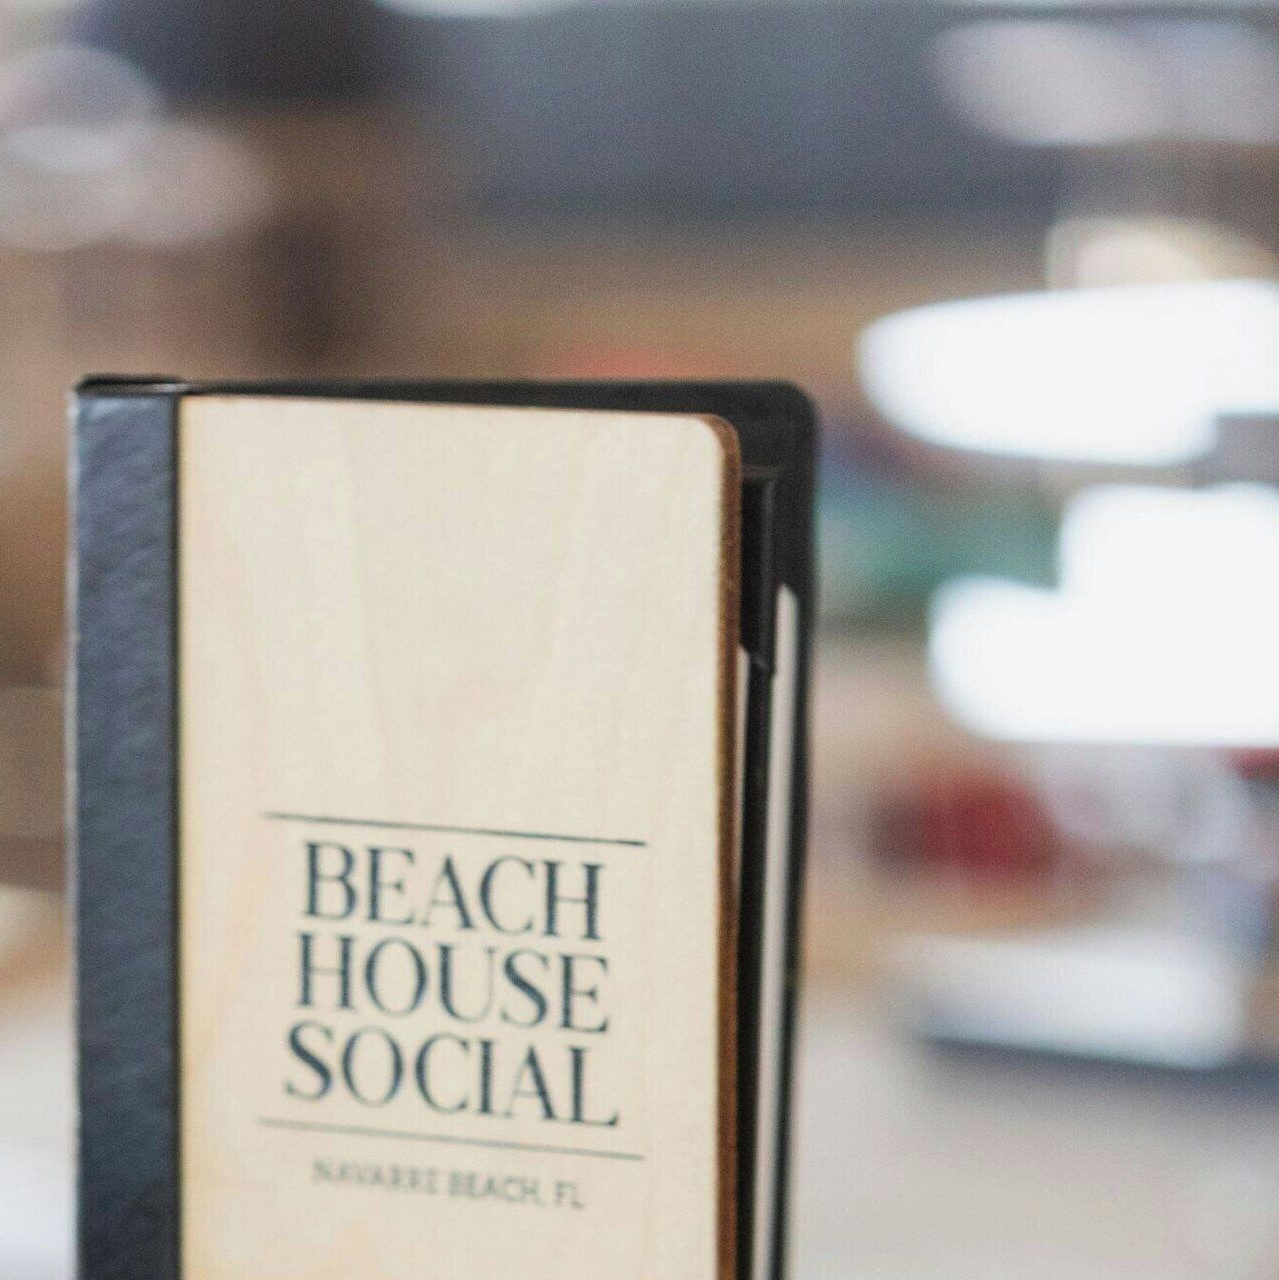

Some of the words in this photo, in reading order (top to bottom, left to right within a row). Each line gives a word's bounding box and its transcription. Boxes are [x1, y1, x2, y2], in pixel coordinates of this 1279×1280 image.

[302, 840, 605, 943] BEACH
[296, 930, 611, 1035] HOUSE
[283, 1019, 621, 1129] SOCIAL
[312, 1160, 438, 1195] NAVARRE
[553, 1180, 585, 1211] FL
